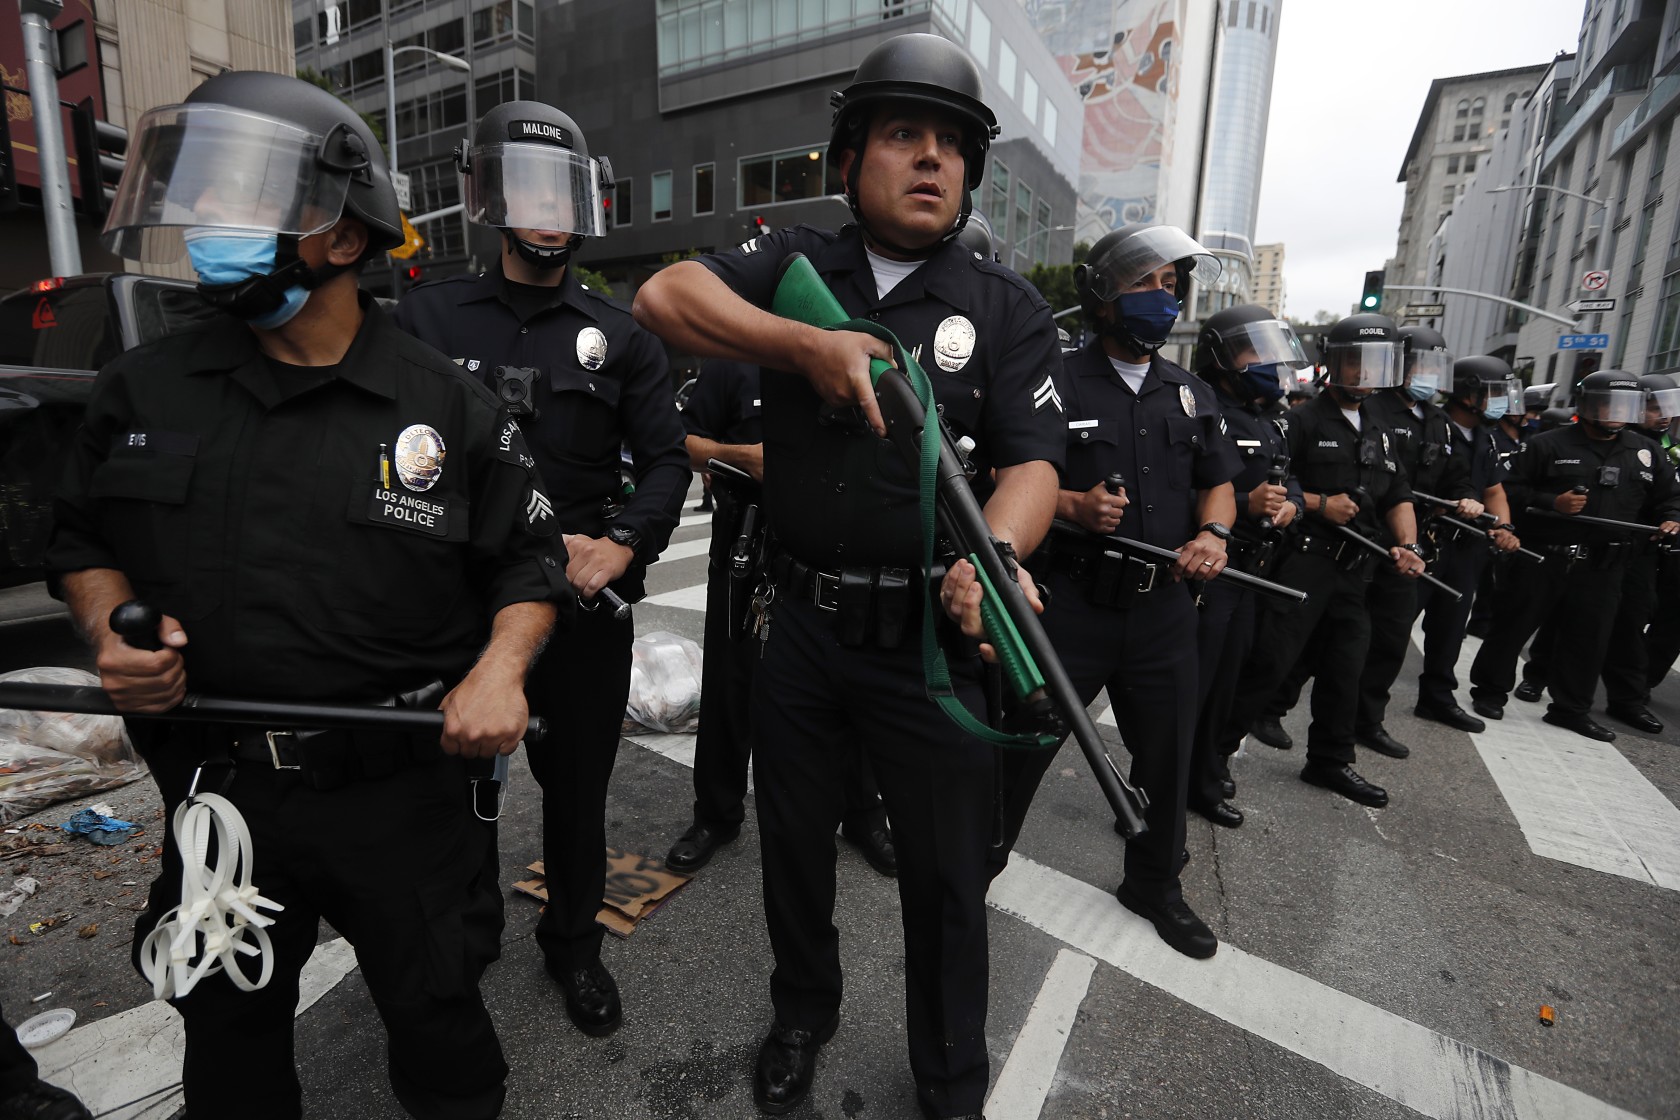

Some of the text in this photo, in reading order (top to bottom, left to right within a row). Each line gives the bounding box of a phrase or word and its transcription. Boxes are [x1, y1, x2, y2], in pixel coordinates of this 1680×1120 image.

[522, 122, 562, 140] MALONE
[1360, 328, 1385, 336] ROGUEL
[1562, 336, 1605, 347] 5th St
[499, 428, 512, 452] LOS
[1318, 440, 1339, 448] ROGUEL
[375, 488, 445, 516] LOS ANGELES
[383, 504, 435, 528] POLICE
